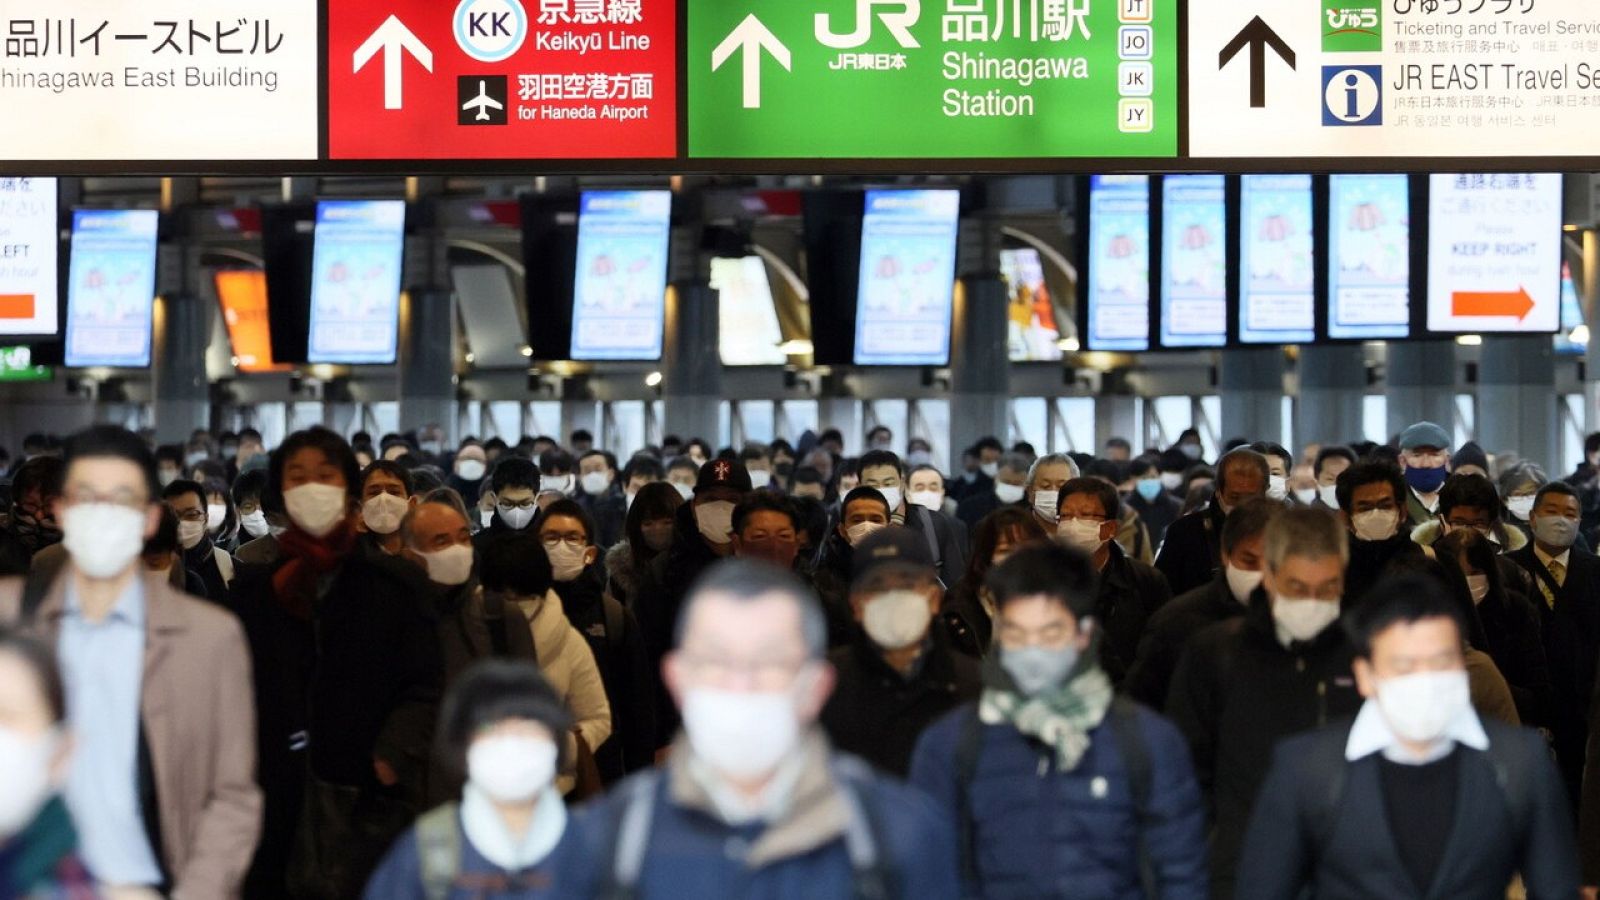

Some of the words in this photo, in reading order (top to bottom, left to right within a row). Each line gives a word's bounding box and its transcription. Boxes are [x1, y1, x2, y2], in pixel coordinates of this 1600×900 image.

[1127, 0, 1143, 13] JT
[469, 11, 512, 37] KK
[814, 0, 921, 49] JR
[941, 0, 1092, 42] 品川駅
[1394, 20, 1463, 38] Ticketing
[1468, 20, 1497, 35] and
[1503, 20, 1550, 35] Travel
[5, 17, 284, 58] 品川イーストビル
[536, 31, 602, 55] Keikyū
[608, 31, 651, 51] Line
[1125, 35, 1146, 51] JO
[1394, 39, 1520, 54] 售票及旅行服务中心
[828, 52, 907, 71] JR東日本
[942, 50, 1089, 86] Shinagawa
[124, 66, 177, 88] East
[184, 66, 279, 94] Building
[518, 73, 653, 100] 羽田空港方面
[1126, 72, 1145, 87] JK
[1393, 63, 1423, 91] JR
[1431, 63, 1495, 91] EAST
[1501, 62, 1569, 91] Travel
[1576, 62, 1600, 90] Se
[942, 88, 1034, 117] Station
[518, 104, 537, 120] for
[541, 104, 597, 120] Haneda
[600, 104, 649, 123] Airport
[1126, 108, 1145, 123] JY
[1393, 115, 1409, 127] JR
[1451, 242, 1490, 257] KEEP
[1494, 242, 1538, 257] RIGHT
